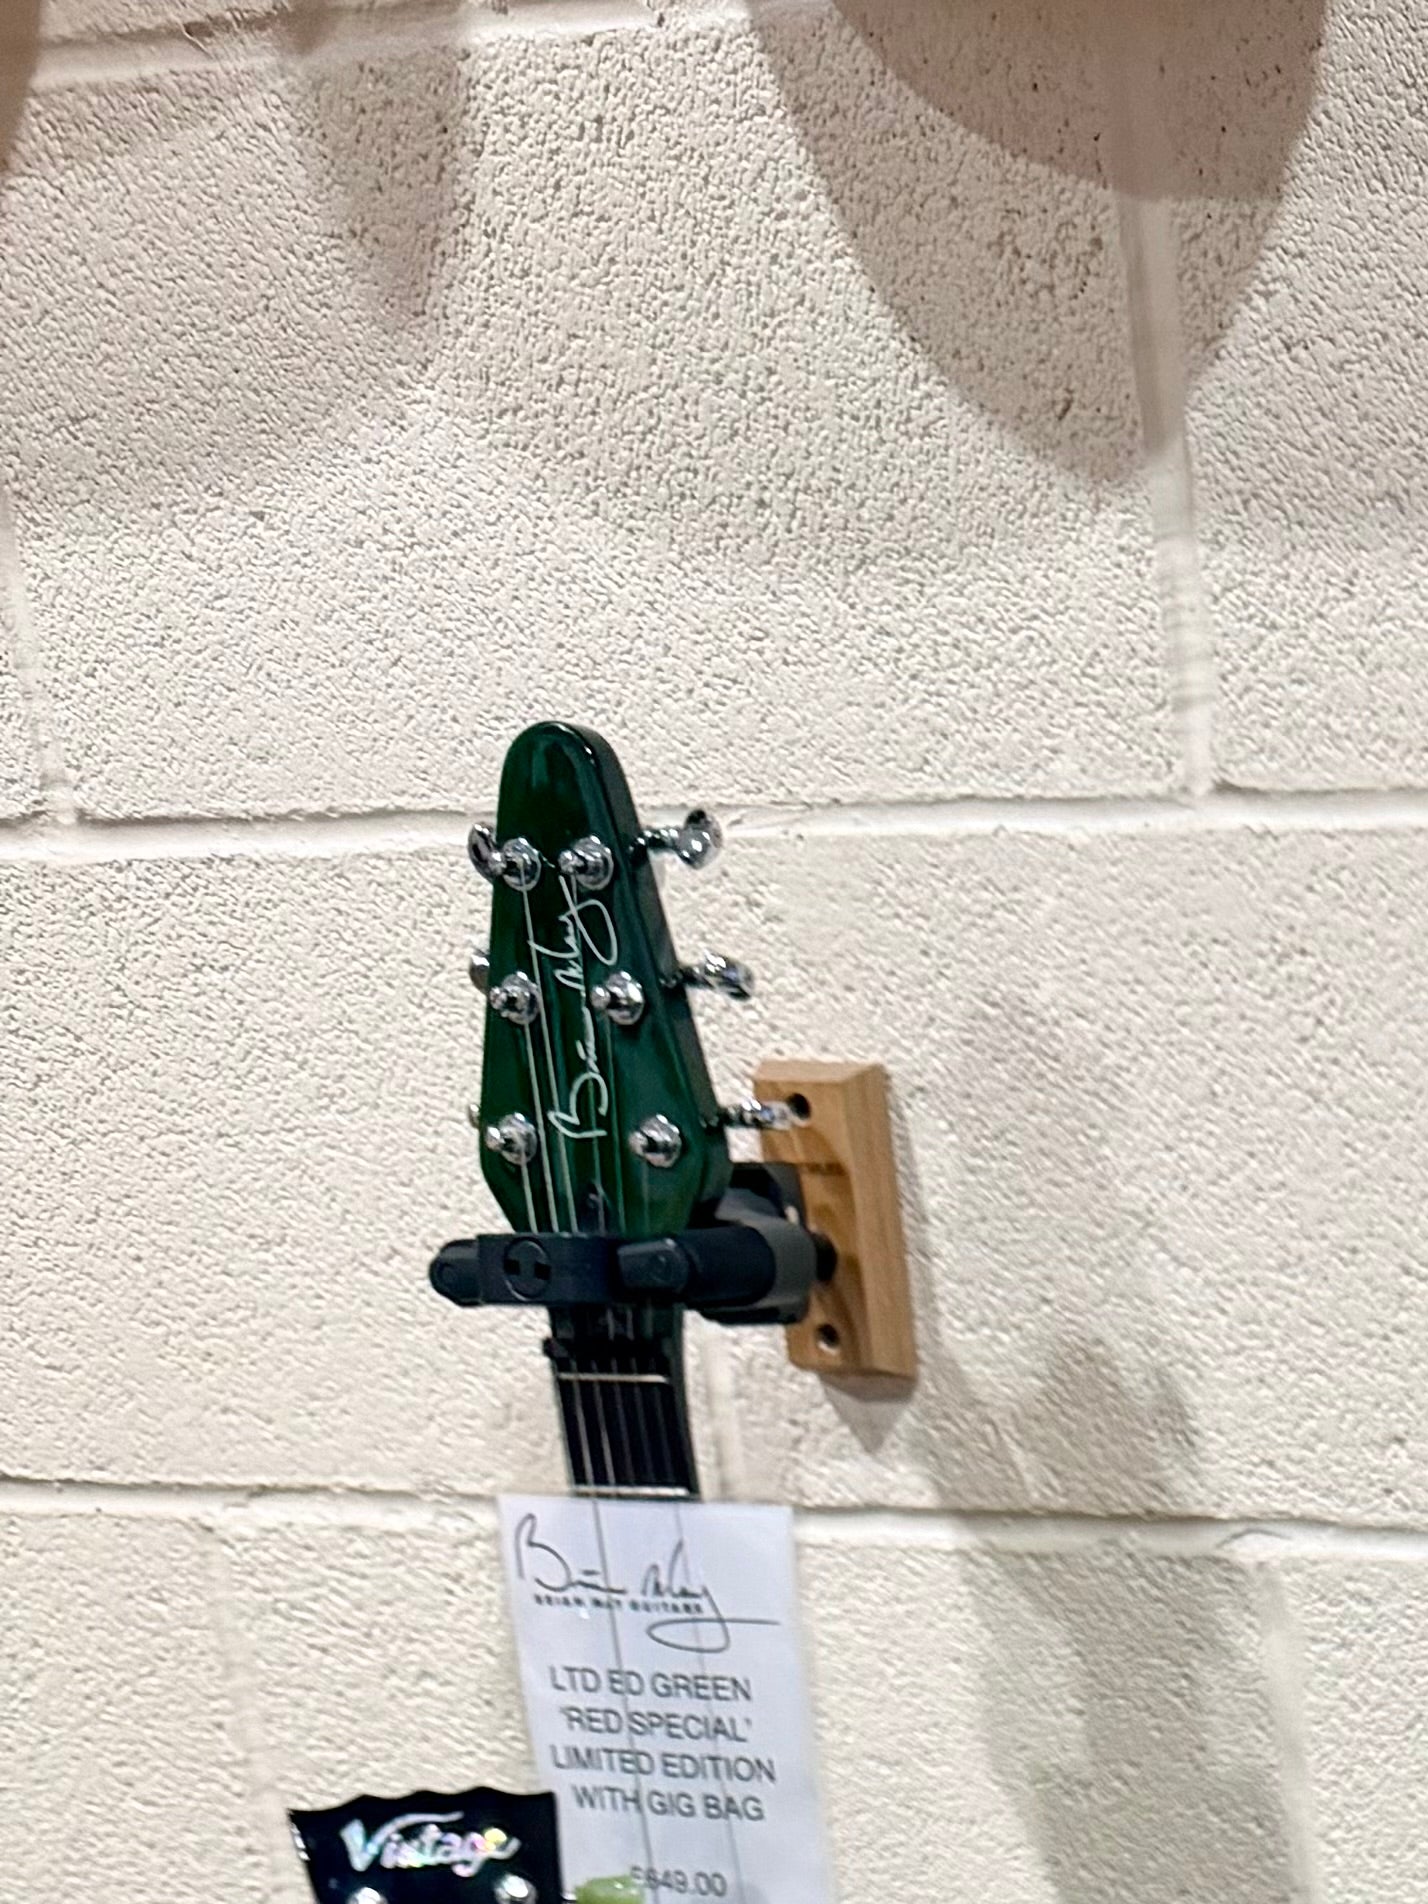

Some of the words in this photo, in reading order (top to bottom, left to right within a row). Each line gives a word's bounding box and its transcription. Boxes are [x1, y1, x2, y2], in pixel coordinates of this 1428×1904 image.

[549, 1665, 601, 1693] LTD
[607, 1668, 645, 1697] ED
[651, 1672, 753, 1702] GREEN
[549, 1744, 655, 1776] LIMITED
[661, 1751, 777, 1783] EDITION
[572, 1785, 642, 1814] WITH
[648, 1790, 696, 1818] GIG
[703, 1794, 765, 1822] BAG
[339, 1810, 522, 1877] Vintage
